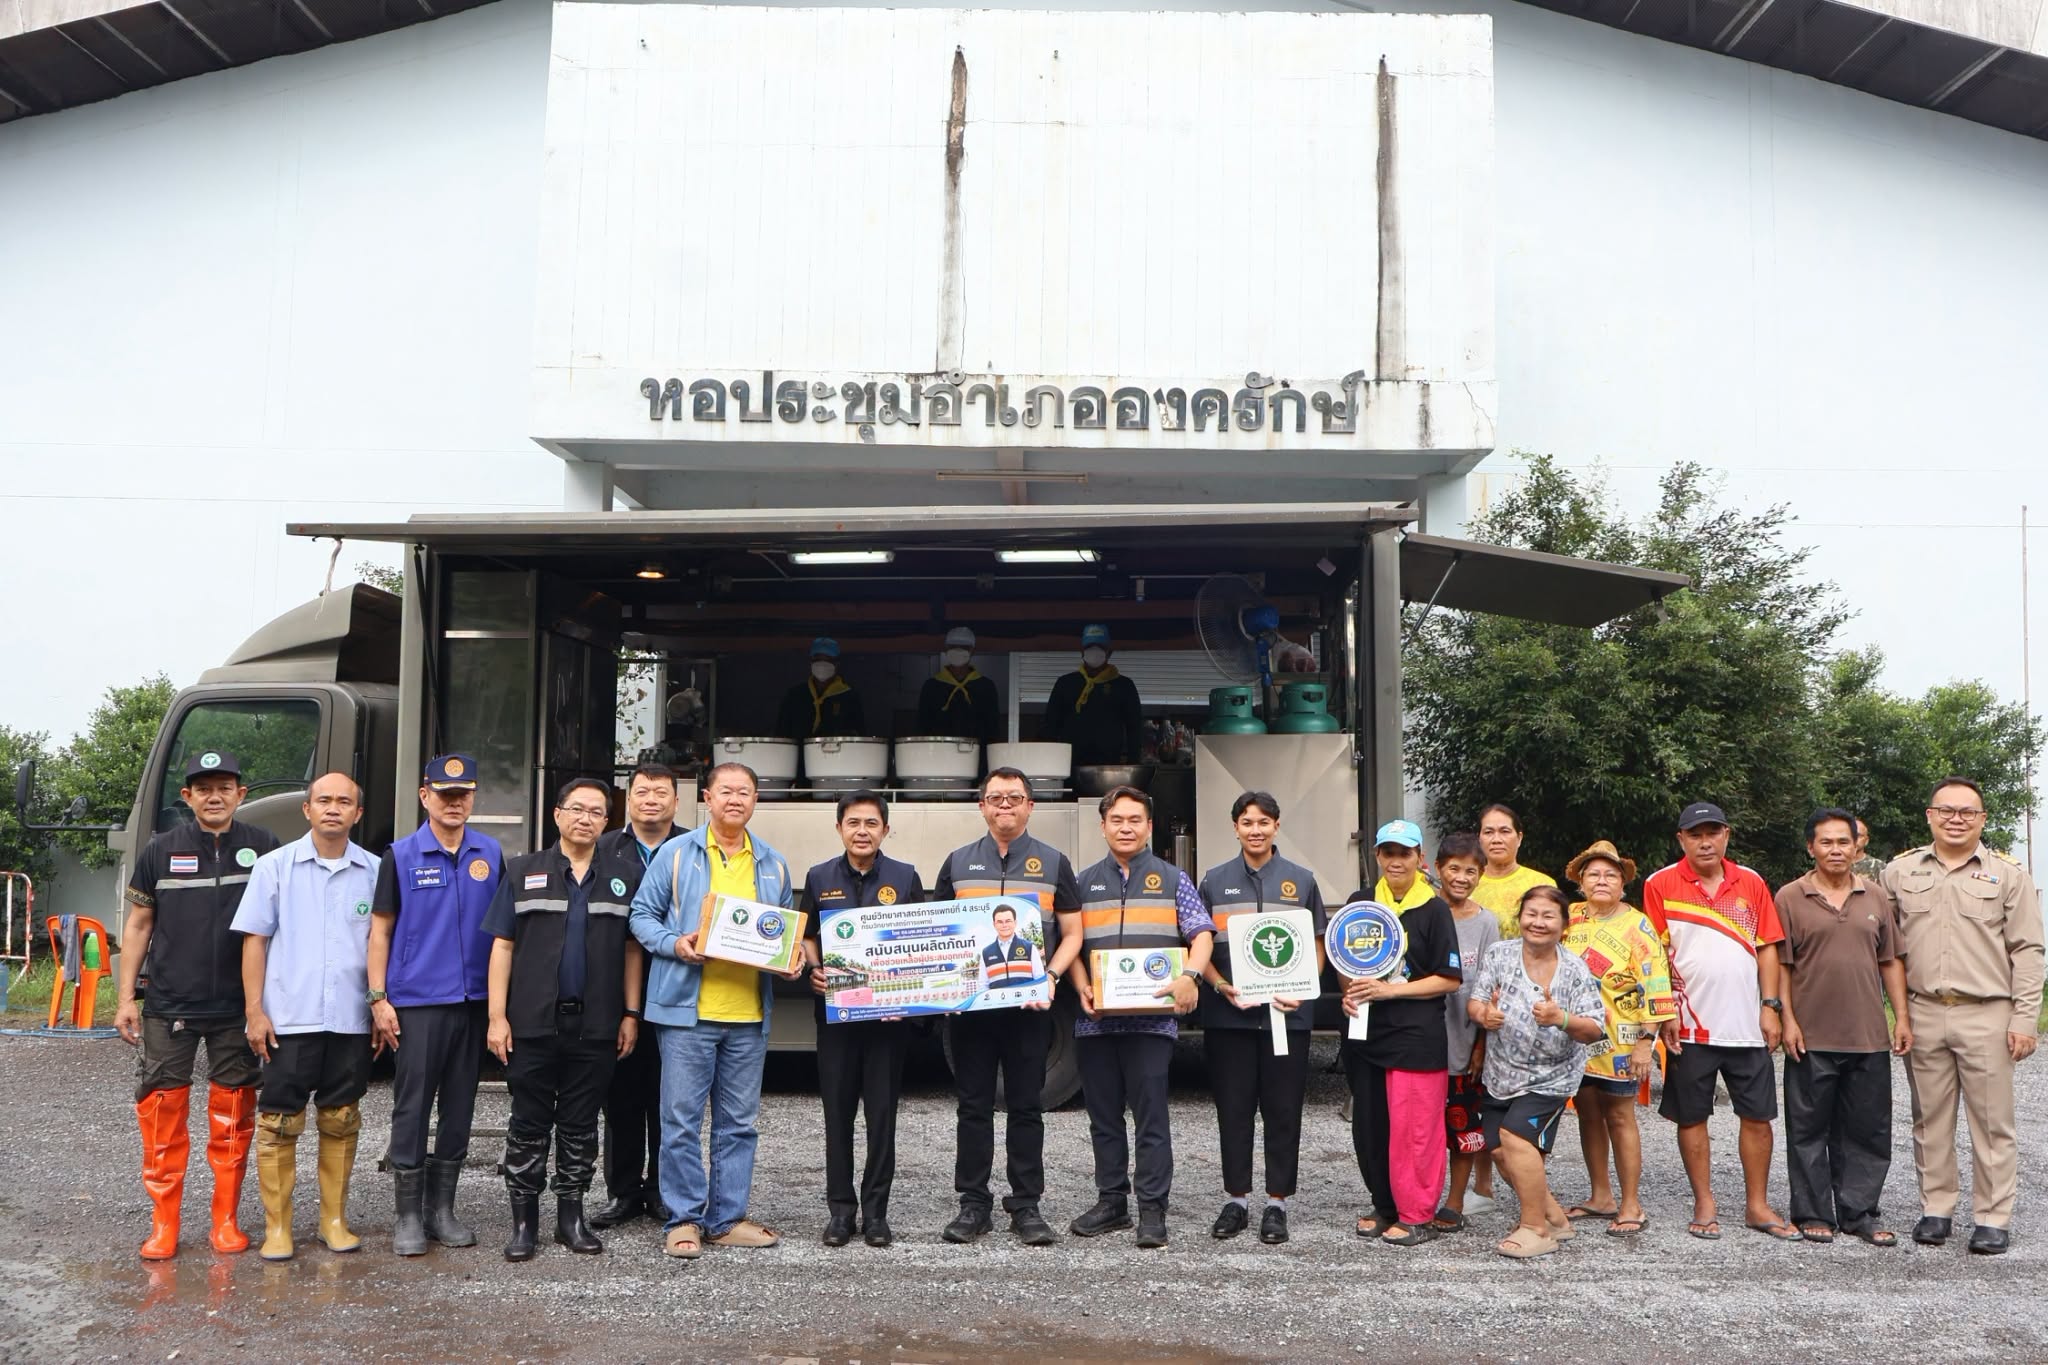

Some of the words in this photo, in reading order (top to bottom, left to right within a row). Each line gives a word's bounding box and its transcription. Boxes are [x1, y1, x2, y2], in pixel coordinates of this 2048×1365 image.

[640, 368, 1365, 443] หอประชุมอำเภอองครักษ์
[962, 905, 968, 913] 4
[969, 902, 991, 914] สระบุรี
[866, 936, 976, 957] สนับสนุนผลิตภัณฑ์
[1344, 937, 1387, 949] LERT
